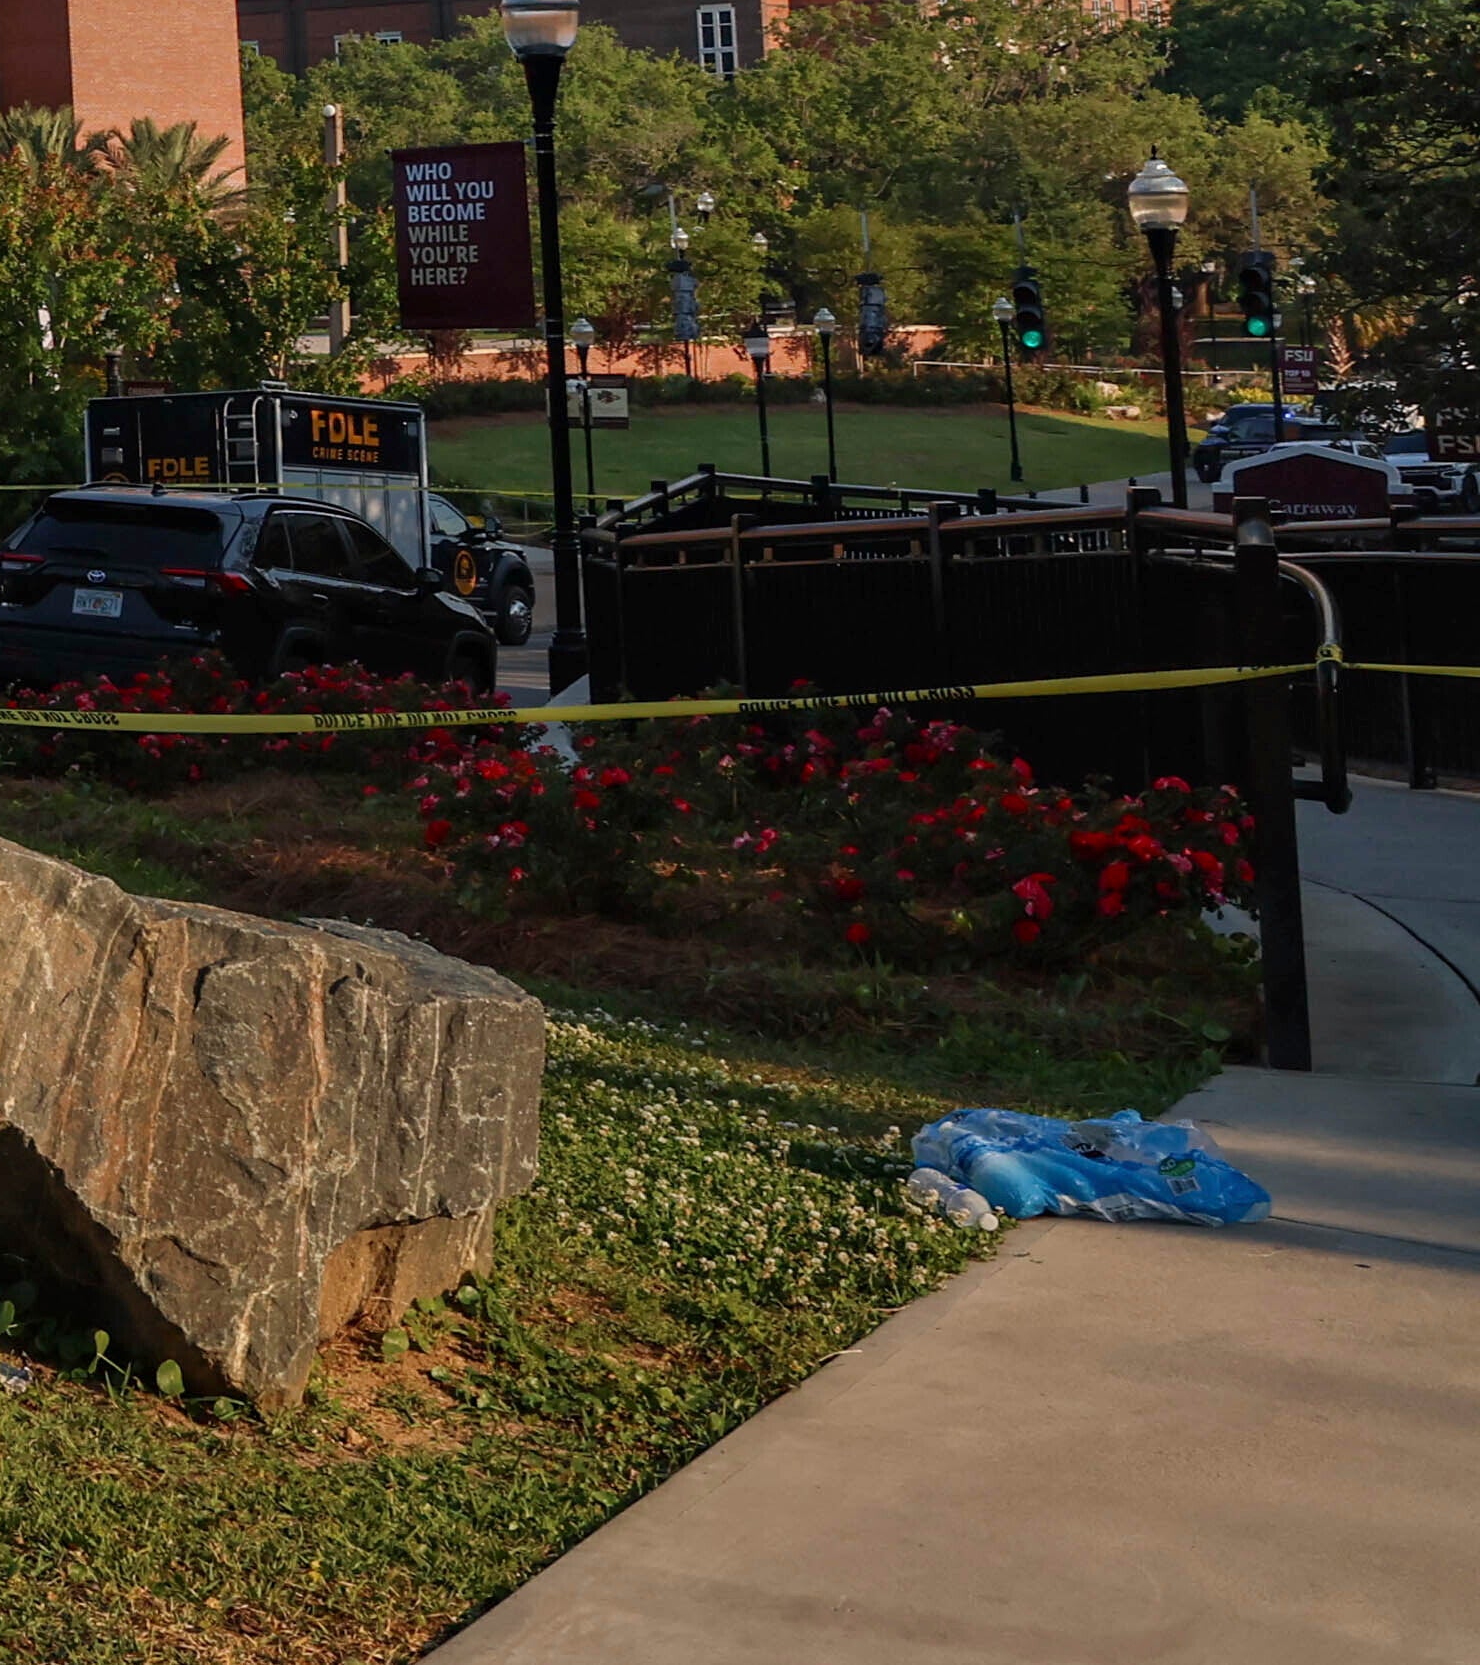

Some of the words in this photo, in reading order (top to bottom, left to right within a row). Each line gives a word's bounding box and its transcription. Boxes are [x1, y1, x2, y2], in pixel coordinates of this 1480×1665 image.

[405, 162, 452, 182] WHO
[406, 183, 451, 202] WILL
[454, 181, 494, 200] YOU
[408, 203, 485, 223] BECOME
[408, 225, 469, 244] WHILE
[409, 245, 479, 265] YOU'RE
[411, 267, 467, 286] HERE?
[1285, 349, 1313, 362] FSU
[311, 409, 380, 447] FDLE
[312, 446, 344, 461] CRIME
[346, 448, 379, 463] SCENE
[148, 457, 210, 478] FDLE
